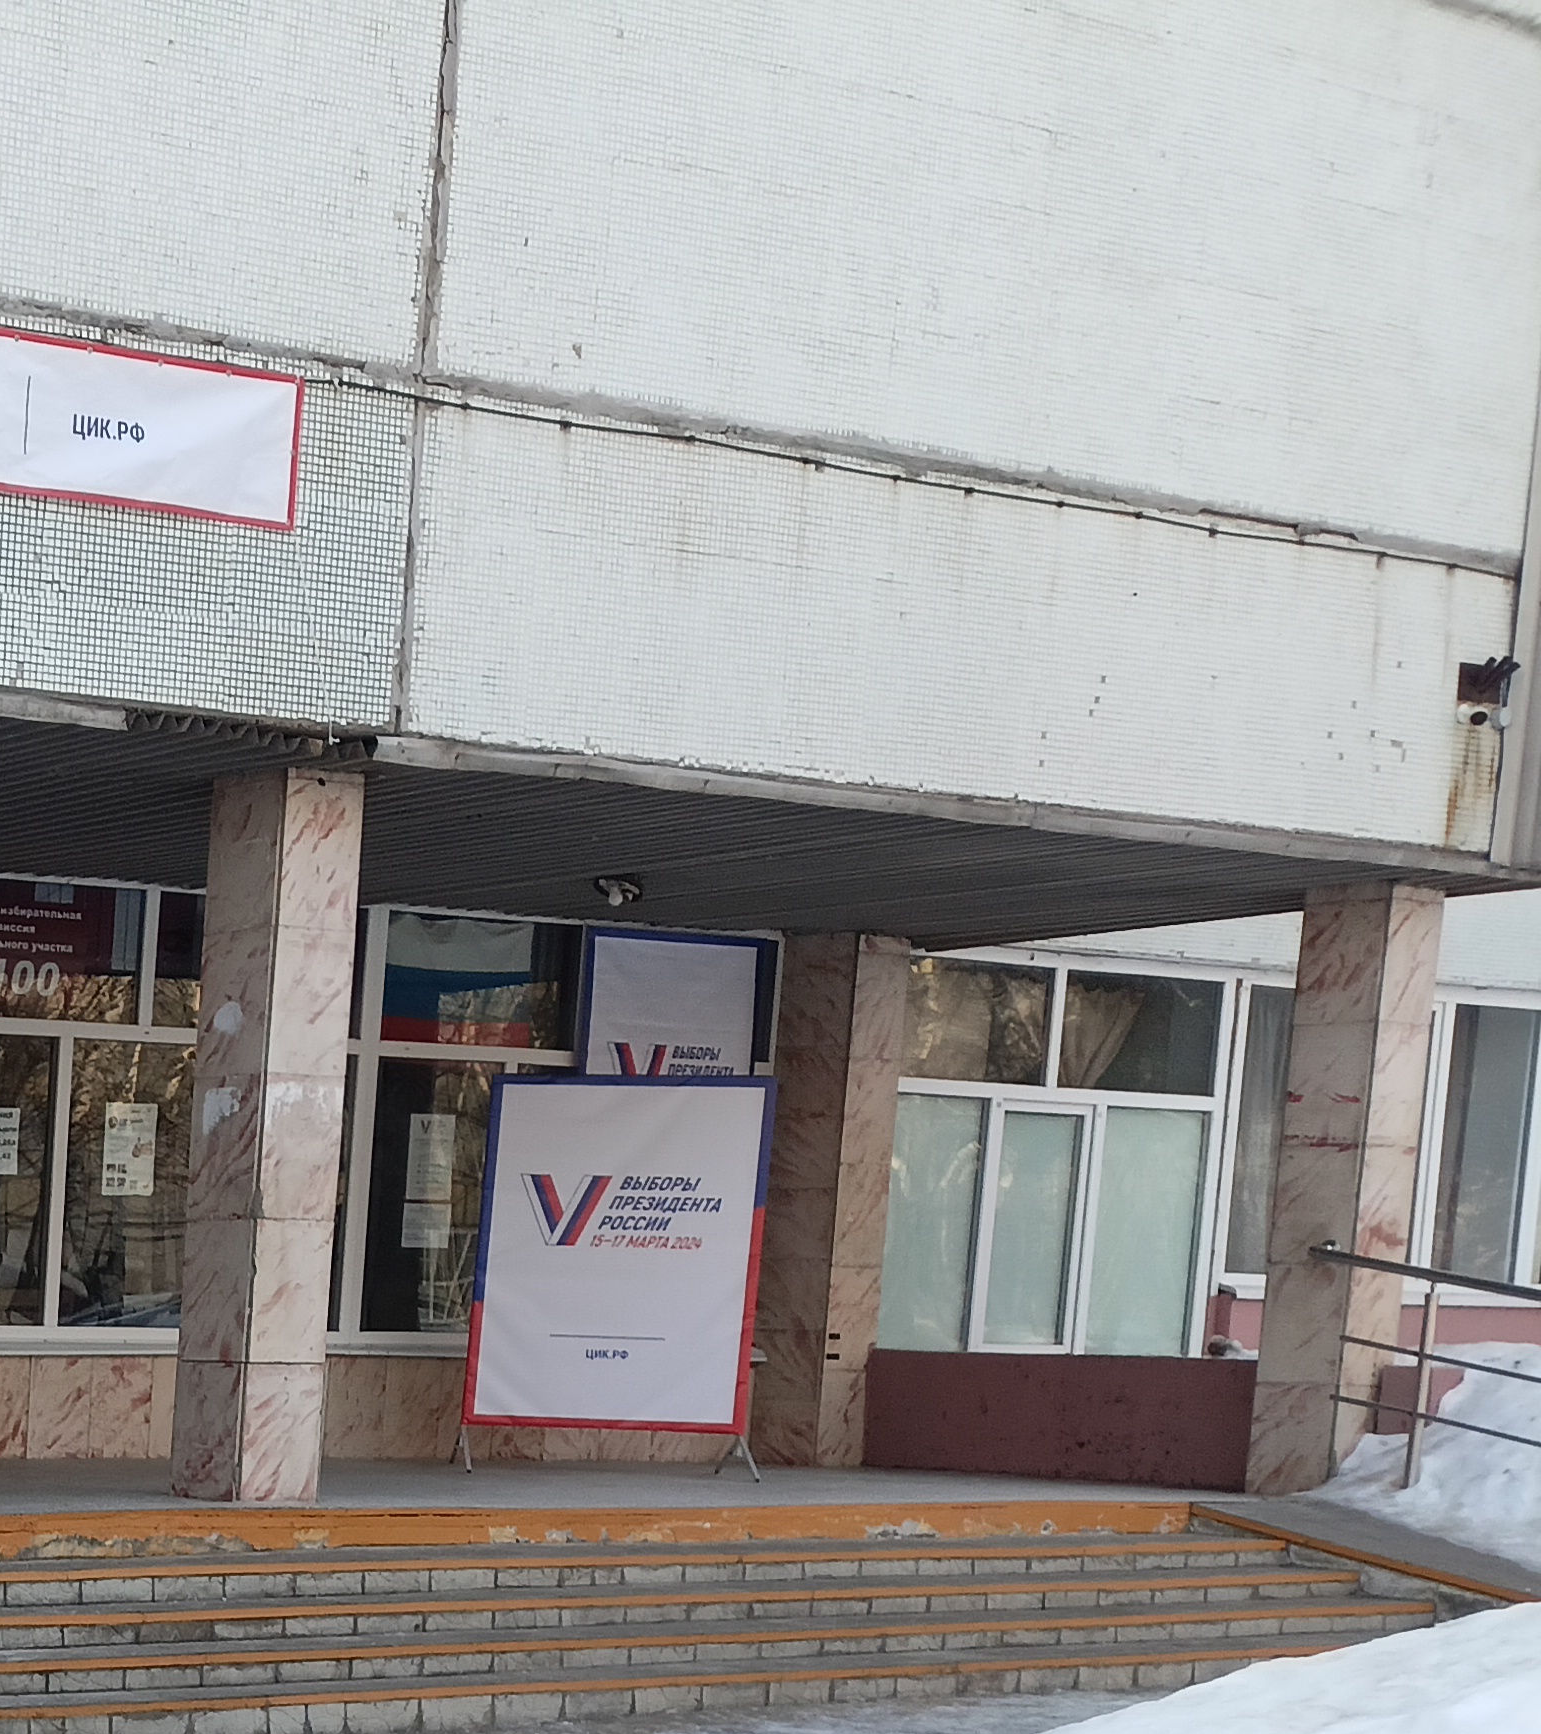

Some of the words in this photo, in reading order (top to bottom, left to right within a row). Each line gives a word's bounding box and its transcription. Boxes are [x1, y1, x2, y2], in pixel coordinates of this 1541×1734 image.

[72, 413, 145, 443] ЦИК.РФ
[0, 905, 82, 920] избирательная
[31, 941, 74, 954] участка
[671, 1045, 722, 1061] ВЫБОРЫ
[619, 1175, 701, 1192] ВЫБОРЫ
[608, 1195, 722, 1214] ПРЕЗИДЕНТА
[597, 1215, 672, 1231] РОССИИ
[624, 1235, 670, 1250] МАРТА
[670, 1236, 703, 1251] 2024
[585, 1349, 629, 1360] ЦИК.РФ
